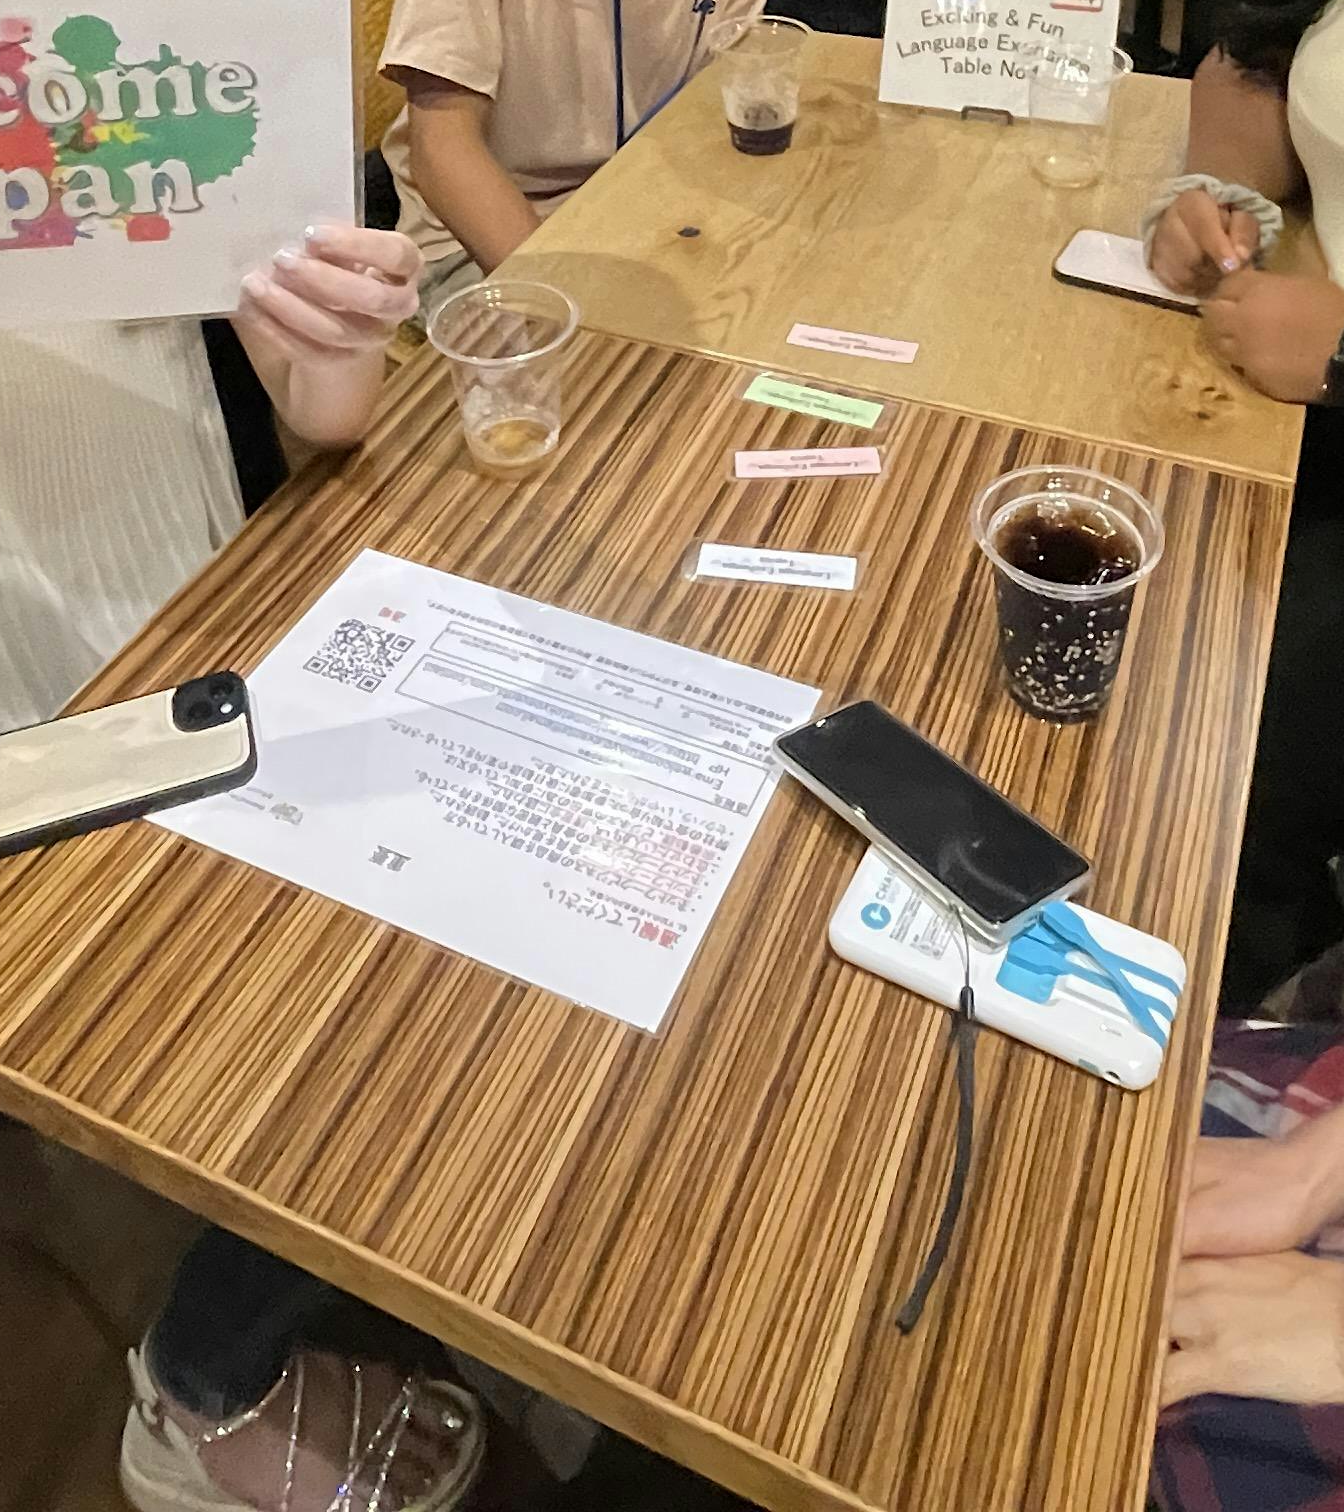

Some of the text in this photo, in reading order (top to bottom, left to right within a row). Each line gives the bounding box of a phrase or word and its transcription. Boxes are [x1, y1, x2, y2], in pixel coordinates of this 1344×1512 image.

[1006, 9, 1019, 26] &
[1028, 13, 1064, 38] Fun
[896, 36, 988, 58] Language
[940, 56, 992, 75] Table
